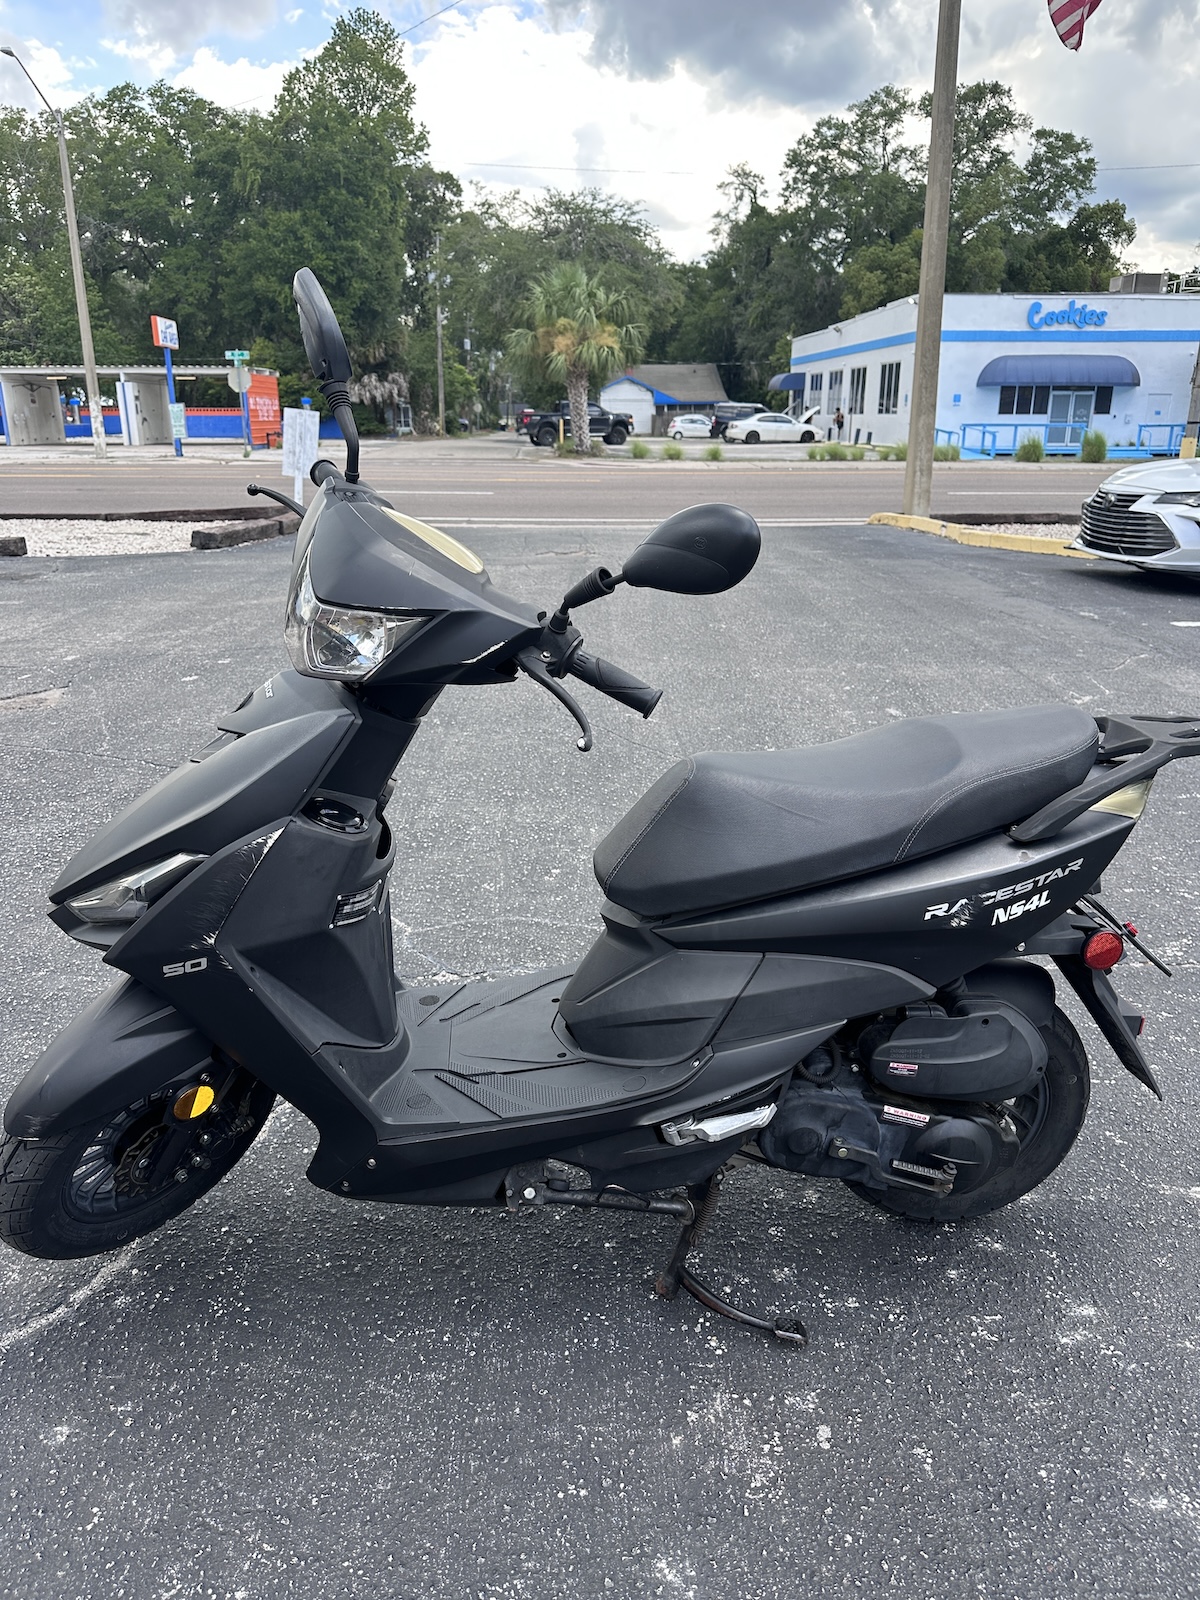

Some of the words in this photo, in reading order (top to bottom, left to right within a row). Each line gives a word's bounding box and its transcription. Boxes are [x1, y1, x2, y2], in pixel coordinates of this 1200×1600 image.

[1027, 300, 1108, 329] Cookies
[991, 890, 1051, 926] NS4L
[162, 957, 208, 978] 50
